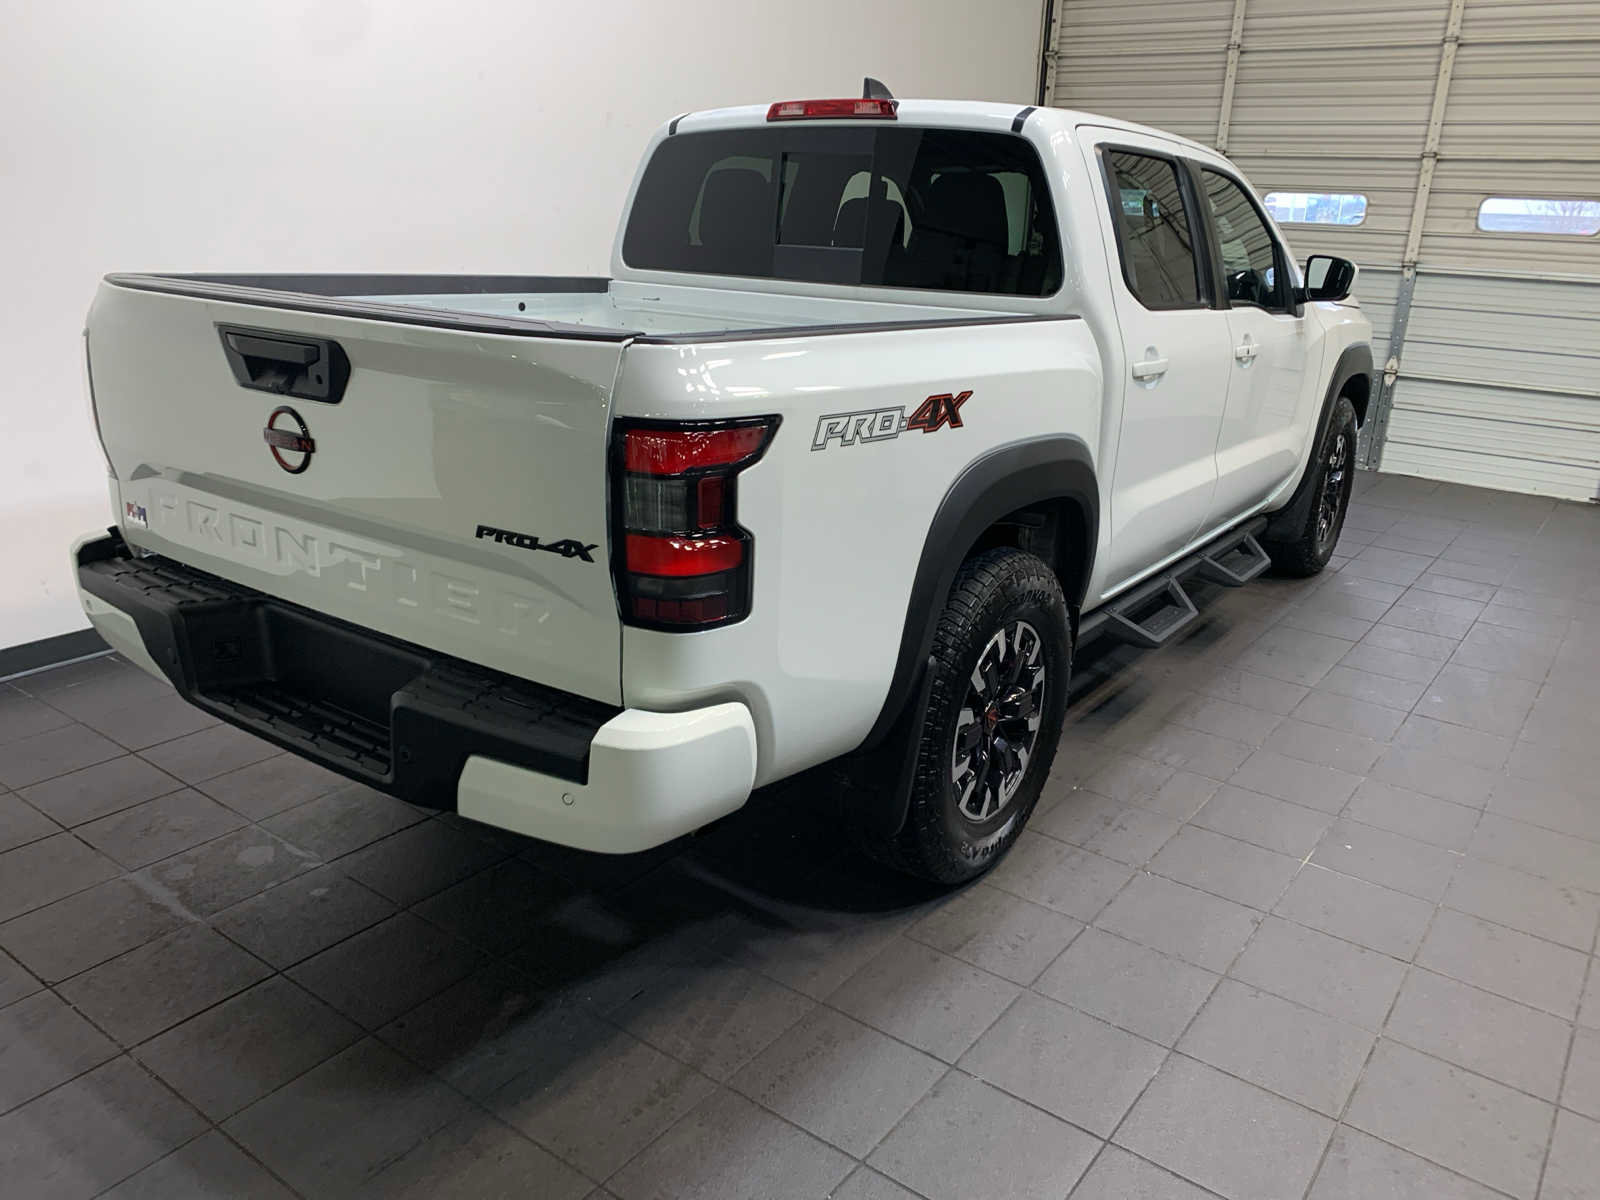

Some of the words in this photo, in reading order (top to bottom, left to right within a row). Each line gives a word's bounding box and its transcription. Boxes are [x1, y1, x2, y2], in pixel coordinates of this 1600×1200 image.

[811, 390, 973, 451] PRO-4X
[149, 490, 553, 643] FRONTIER
[475, 524, 599, 563] PRO-4X
